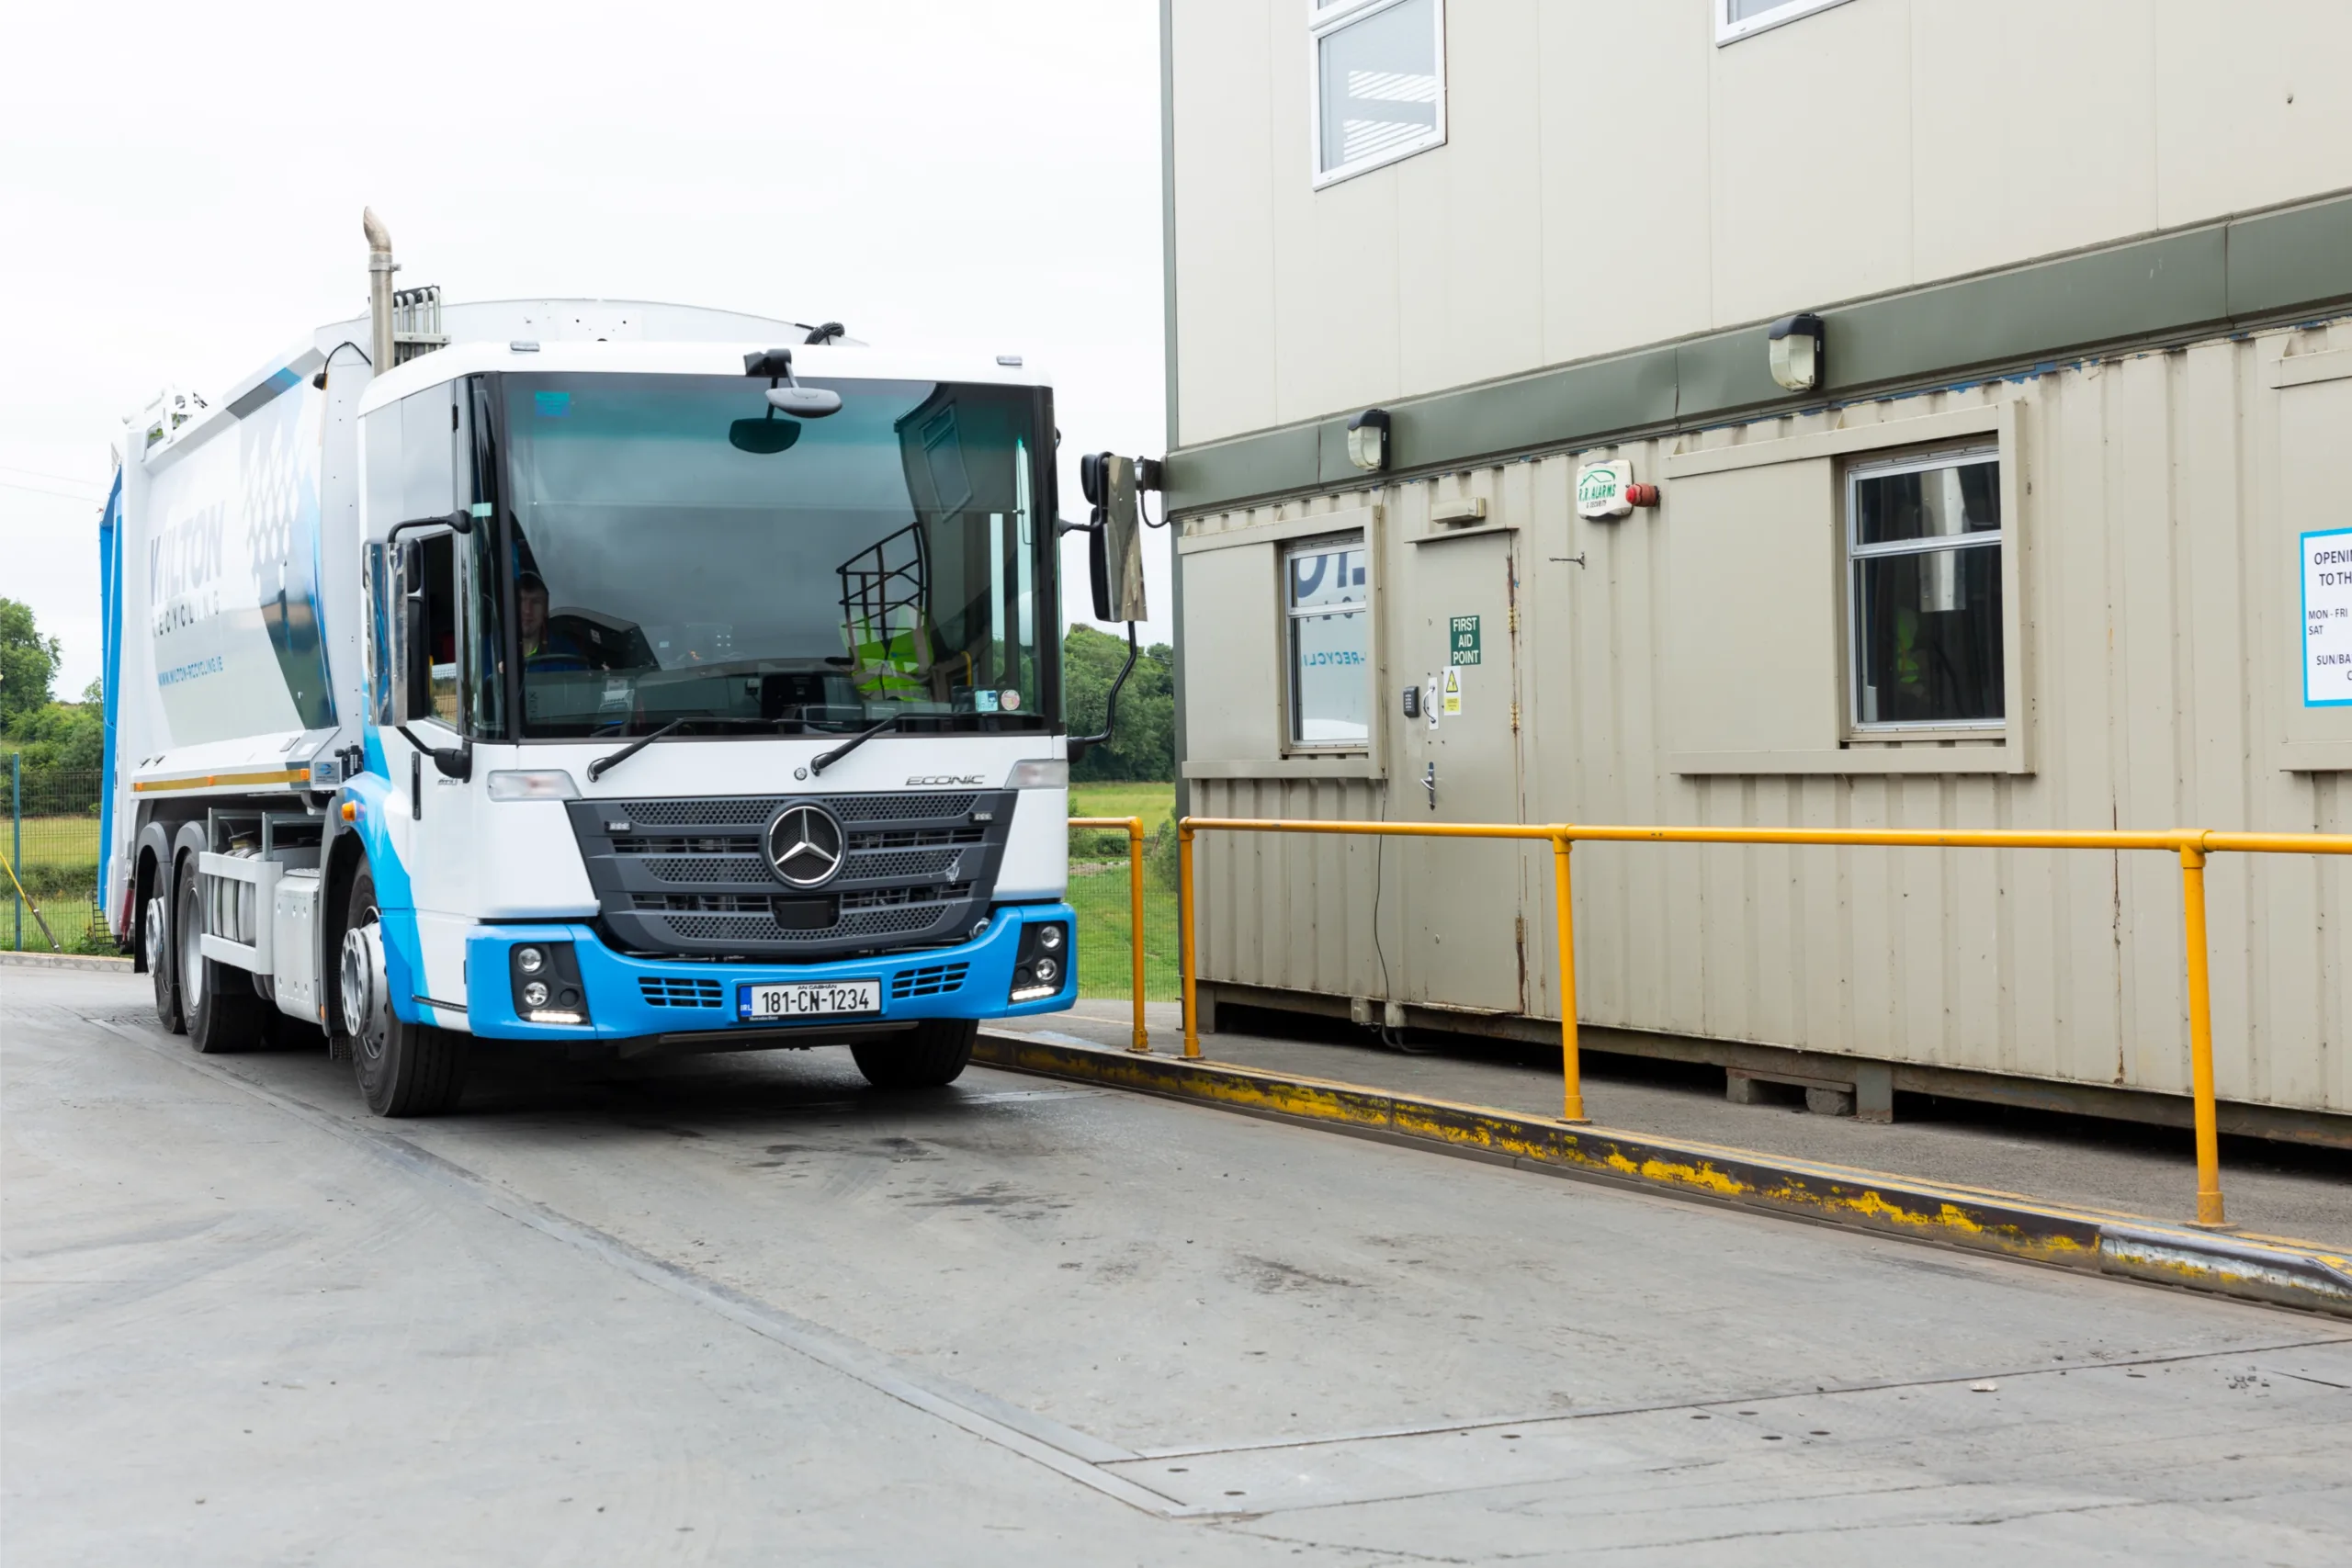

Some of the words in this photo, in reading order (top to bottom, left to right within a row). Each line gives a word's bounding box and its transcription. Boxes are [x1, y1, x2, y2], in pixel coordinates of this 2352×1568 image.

[1591, 484, 1616, 499] ALARMS
[2314, 549, 2352, 565] OPENI
[2319, 573, 2335, 586] TO
[2336, 571, 2352, 585] TH
[153, 591, 219, 638] RECYCLING
[2308, 609, 2328, 620] MON
[2335, 608, 2348, 618] FRI
[1453, 617, 1477, 632] FIRST
[2308, 626, 2324, 635] SAT
[1458, 634, 1473, 648] AID
[1453, 650, 1478, 664] POINT
[2316, 654, 2352, 665] SUN/BA
[905, 774, 985, 785] ECONIC
[762, 988, 869, 1013] 181-CN-1234
